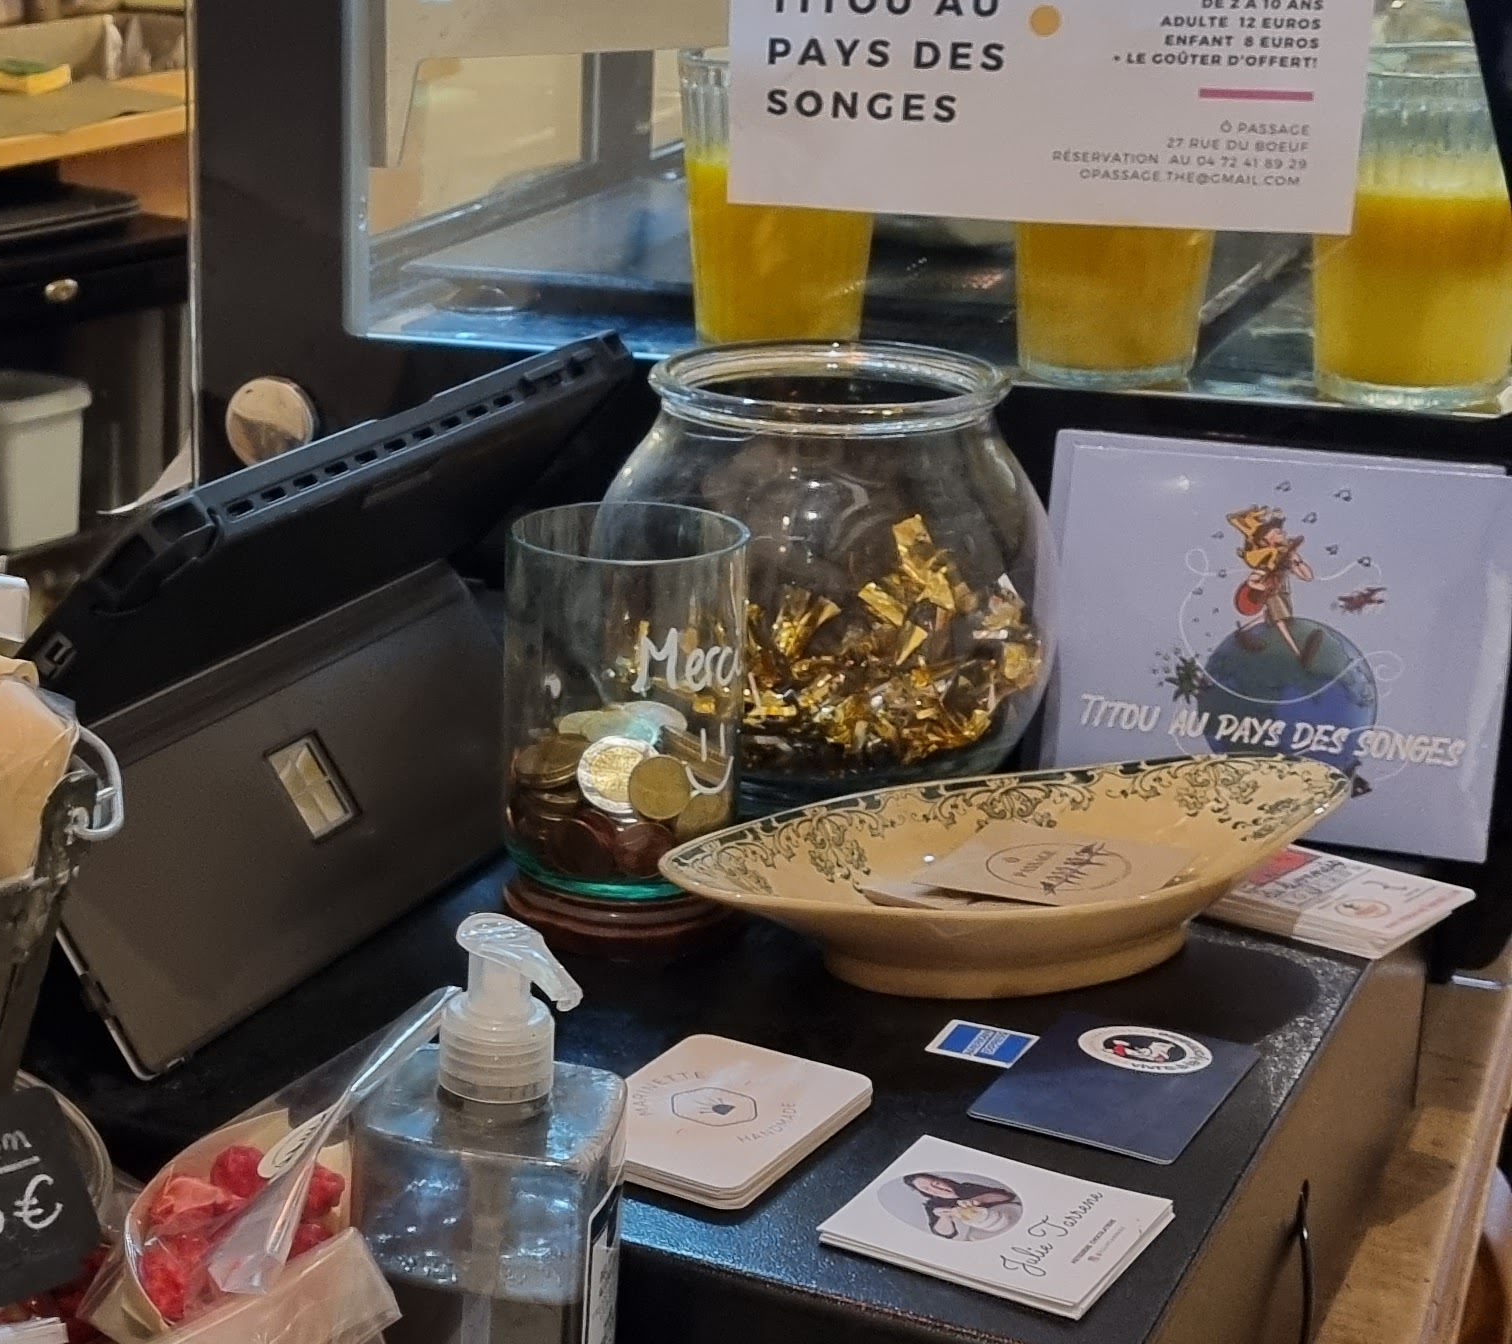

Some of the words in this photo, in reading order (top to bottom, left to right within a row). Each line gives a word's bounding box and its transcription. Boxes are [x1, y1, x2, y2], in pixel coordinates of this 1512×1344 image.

[1286, 0, 1325, 11] ANS
[1160, 16, 1229, 29] ADULTE
[1239, 17, 1257, 29] 12
[1261, 17, 1322, 30] EUROS
[1164, 35, 1234, 47] ENFANT
[1243, 36, 1255, 47] 8
[1260, 36, 1320, 49] EUROS
[766, 37, 891, 69] PAYS
[912, 40, 1007, 72] DES
[1126, 52, 1146, 65] LE
[1151, 50, 1222, 66] GOÛTER
[1227, 54, 1318, 69] D'OFFERT!
[765, 88, 958, 124] SONGES
[1219, 119, 1233, 133] Ô
[1237, 122, 1311, 136] PASSAGE
[1167, 137, 1185, 149] 27
[1188, 138, 1220, 150] RUE
[1226, 139, 1249, 152] DU
[1254, 140, 1311, 153] BOEUF
[1051, 149, 1160, 165] RÉSERVATION
[1168, 155, 1191, 166] AU
[1196, 156, 1216, 167] 04
[1220, 156, 1237, 168] 72
[1241, 157, 1259, 168] 41
[1080, 692, 1161, 733] TITOU
[1168, 707, 1211, 739] AU
[1214, 712, 1288, 749] PAYS
[1289, 721, 1350, 755] DES
[1353, 727, 1468, 769] SONGES
[632, 1069, 707, 1118] MARINETTE
[736, 1101, 798, 1144] HANDMADE
[999, 1242, 1054, 1278] Julie
